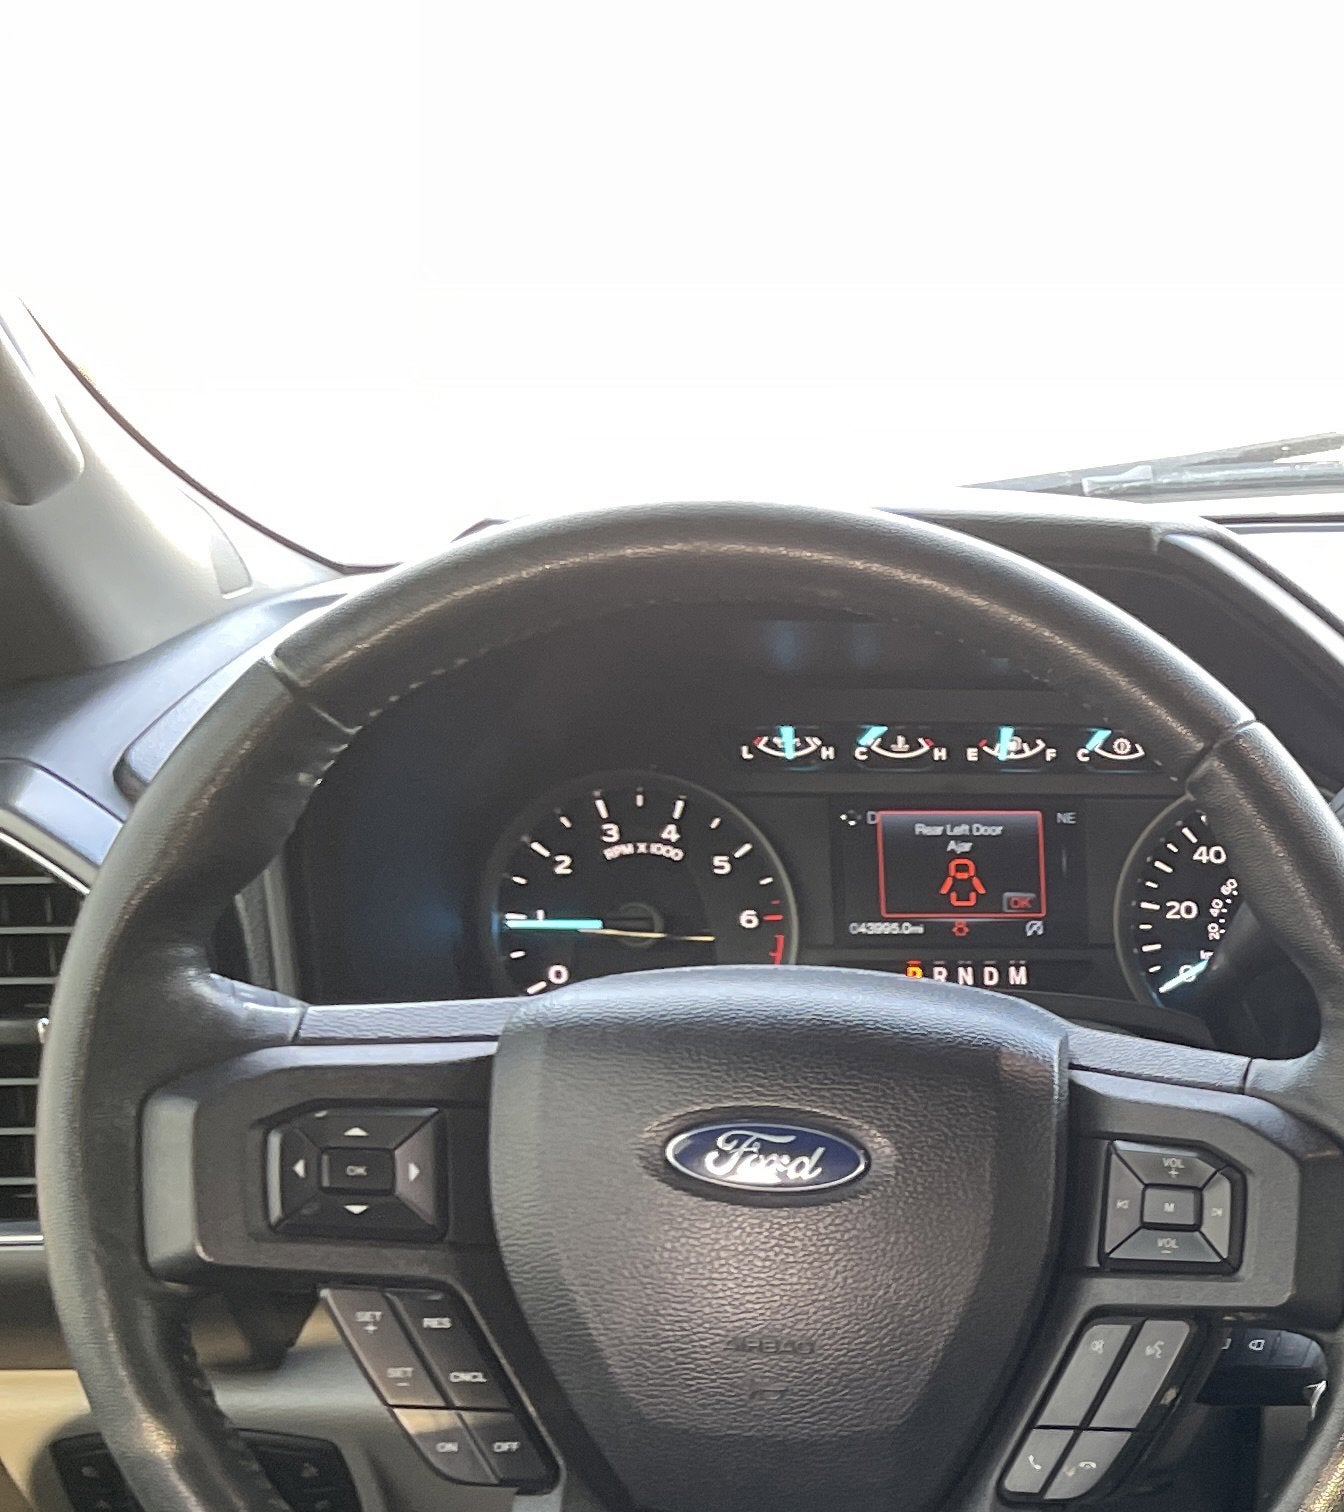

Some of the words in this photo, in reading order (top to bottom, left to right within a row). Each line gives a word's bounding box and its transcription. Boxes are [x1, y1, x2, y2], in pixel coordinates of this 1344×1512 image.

[742, 746, 753, 759] L
[821, 747, 834, 761] H
[855, 747, 868, 761] C
[934, 747, 947, 761] H
[967, 748, 978, 761] E
[1045, 748, 1056, 761] F
[1077, 748, 1090, 762] C
[1057, 812, 1077, 824] NE
[601, 823, 620, 842] 3
[661, 824, 681, 842] 4
[915, 823, 944, 835] Rear
[946, 824, 970, 835] Left
[972, 823, 1003, 835] Door
[603, 843, 634, 860] RPM
[650, 843, 684, 861] 1000
[946, 840, 973, 854] Ajar
[1193, 846, 1227, 864] 40
[554, 855, 573, 874] 2
[712, 856, 731, 875] 5
[1010, 897, 1031, 908] OK
[1166, 901, 1198, 919] 20
[739, 909, 759, 928] 6
[548, 965, 569, 984] 0
[933, 966, 948, 982] R
[957, 966, 974, 985] N
[983, 966, 999, 985] D
[1008, 966, 1028, 985] M
[704, 1130, 825, 1181] Ford
[1162, 1158, 1185, 1169] VOL
[346, 1165, 368, 1176] OK
[1164, 1202, 1175, 1212] M
[1157, 1238, 1179, 1249] VOL
[355, 1311, 382, 1322] SET
[422, 1317, 452, 1328] RES
[387, 1367, 414, 1378] SET
[449, 1371, 487, 1383] CNCL
[436, 1442, 458, 1452] ON
[493, 1441, 520, 1452] OFF
